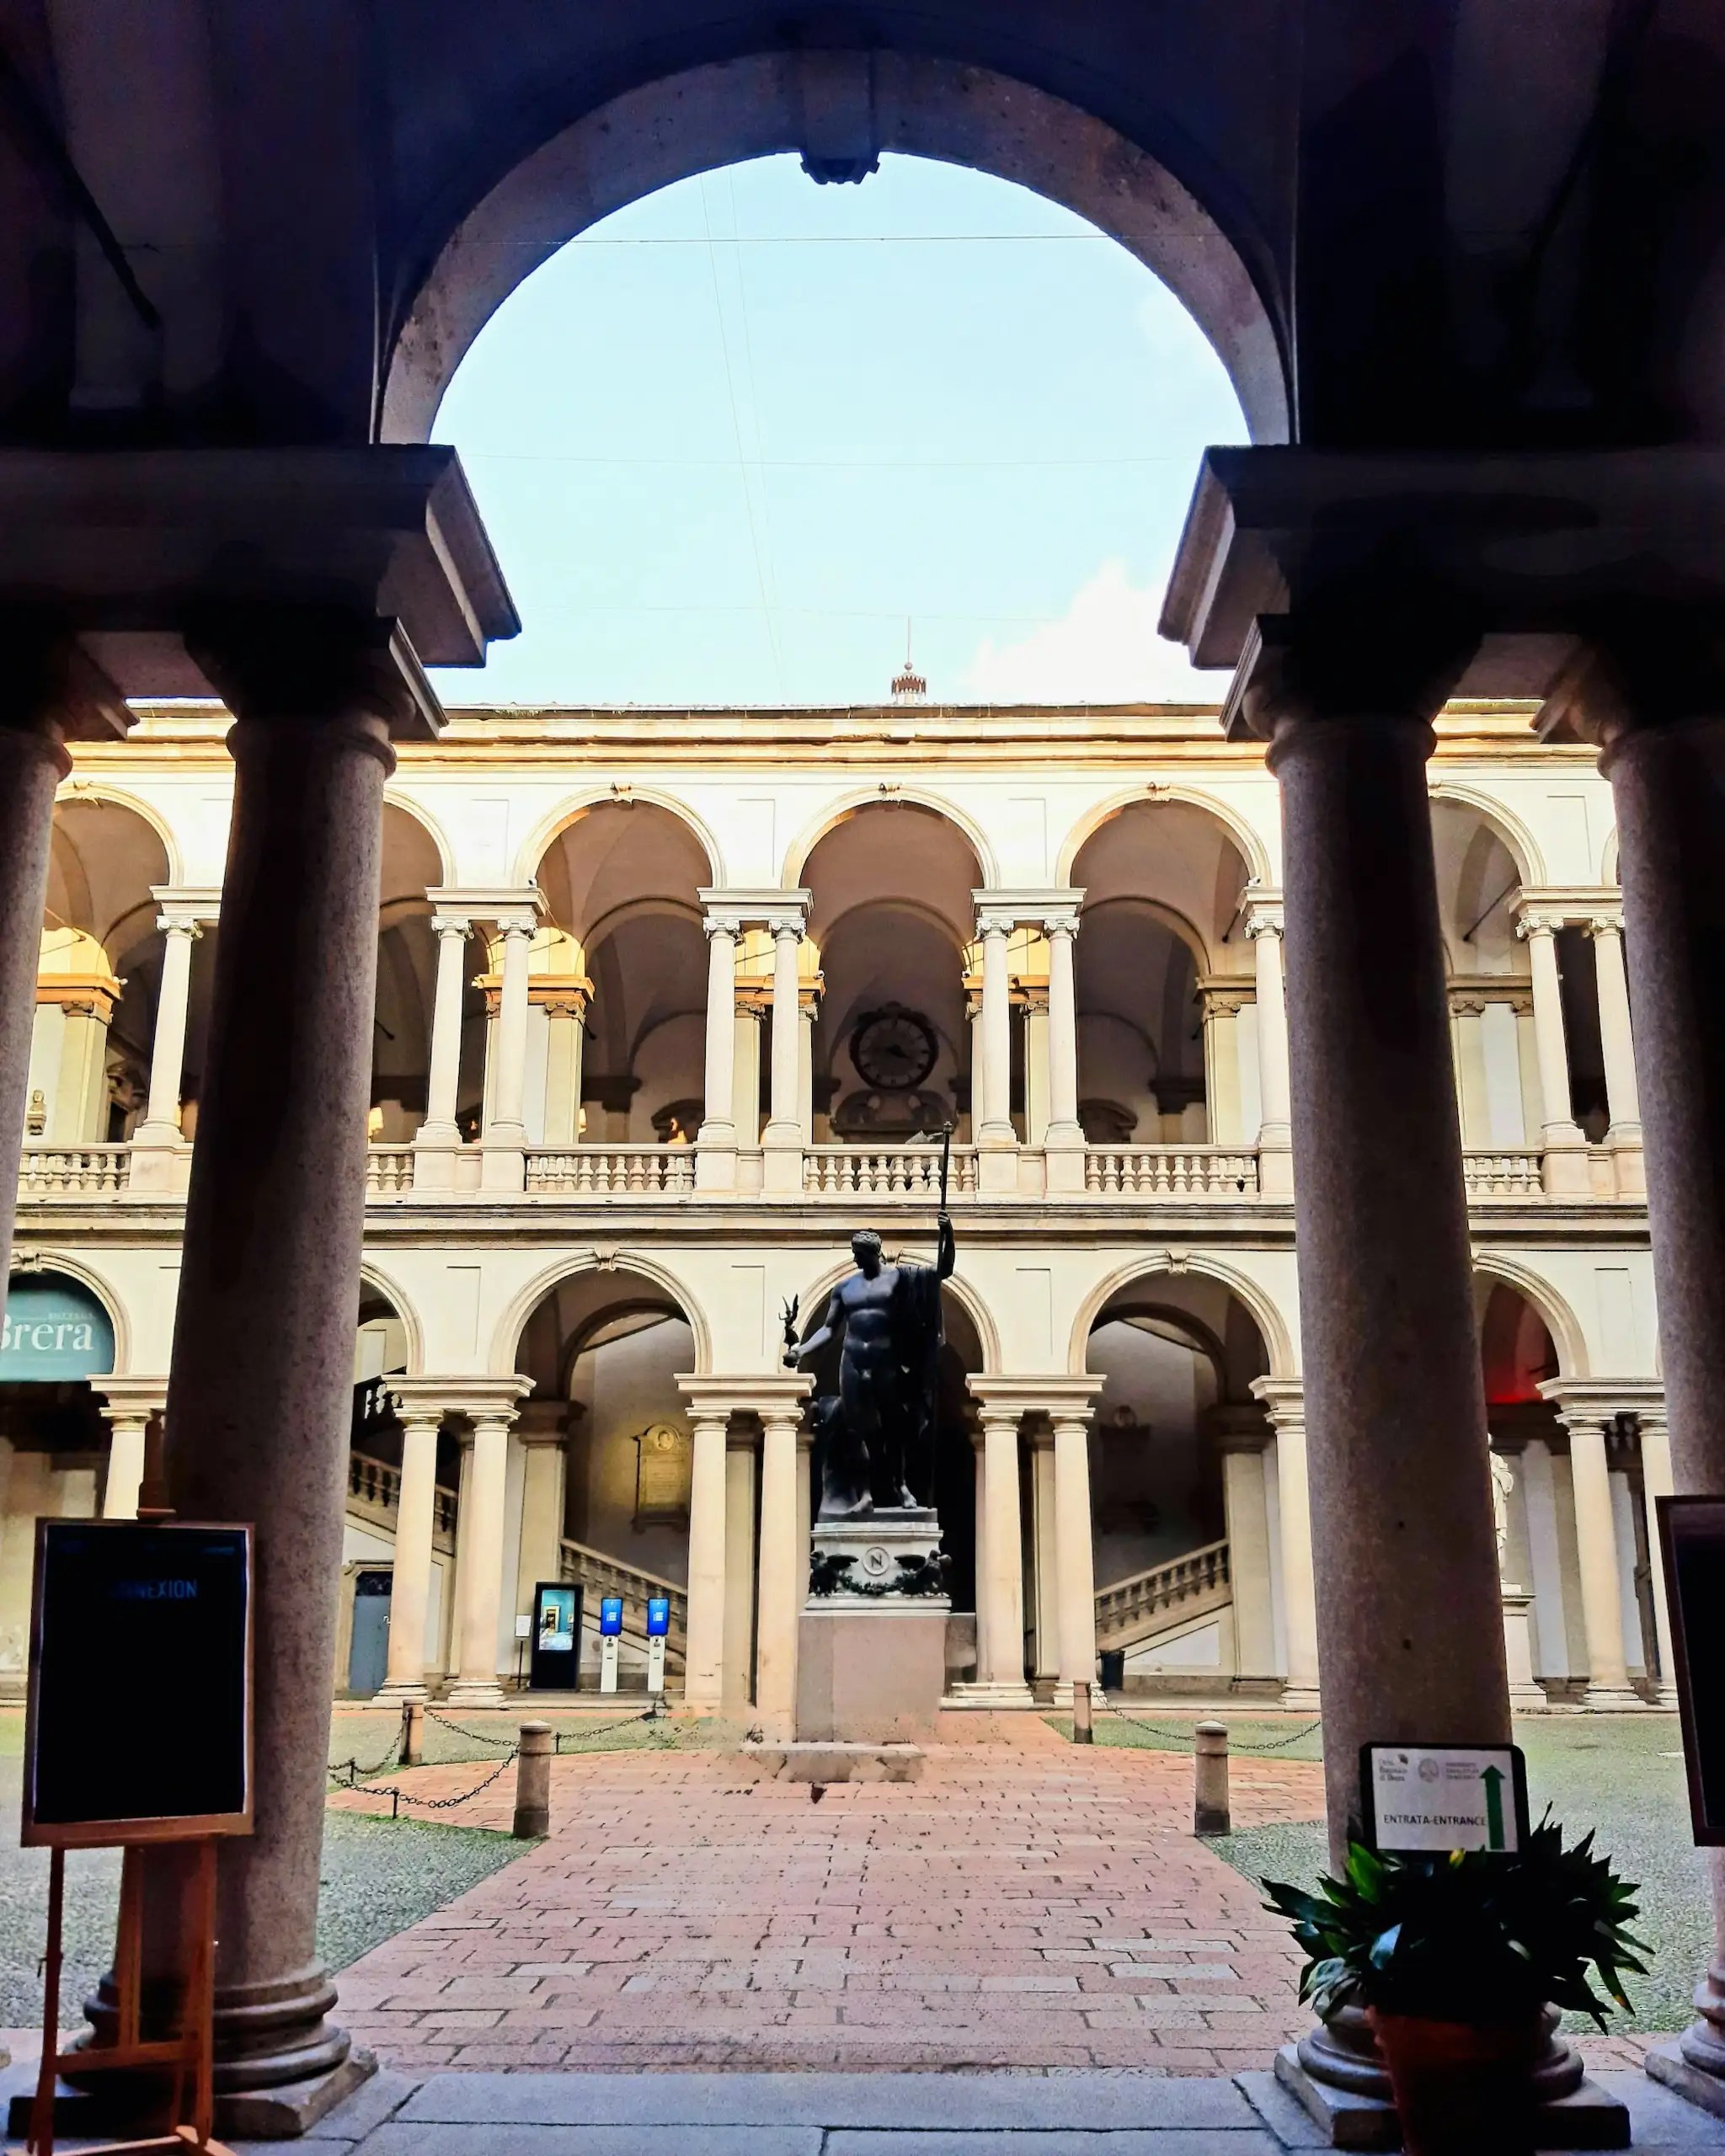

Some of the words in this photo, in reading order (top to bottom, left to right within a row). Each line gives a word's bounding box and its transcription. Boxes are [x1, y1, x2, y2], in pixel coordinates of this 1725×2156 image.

[871, 1555, 883, 1569] N
[108, 1579, 198, 1598] EXION
[1383, 1814, 1487, 1827] ENTRATA-ENTRANCE
